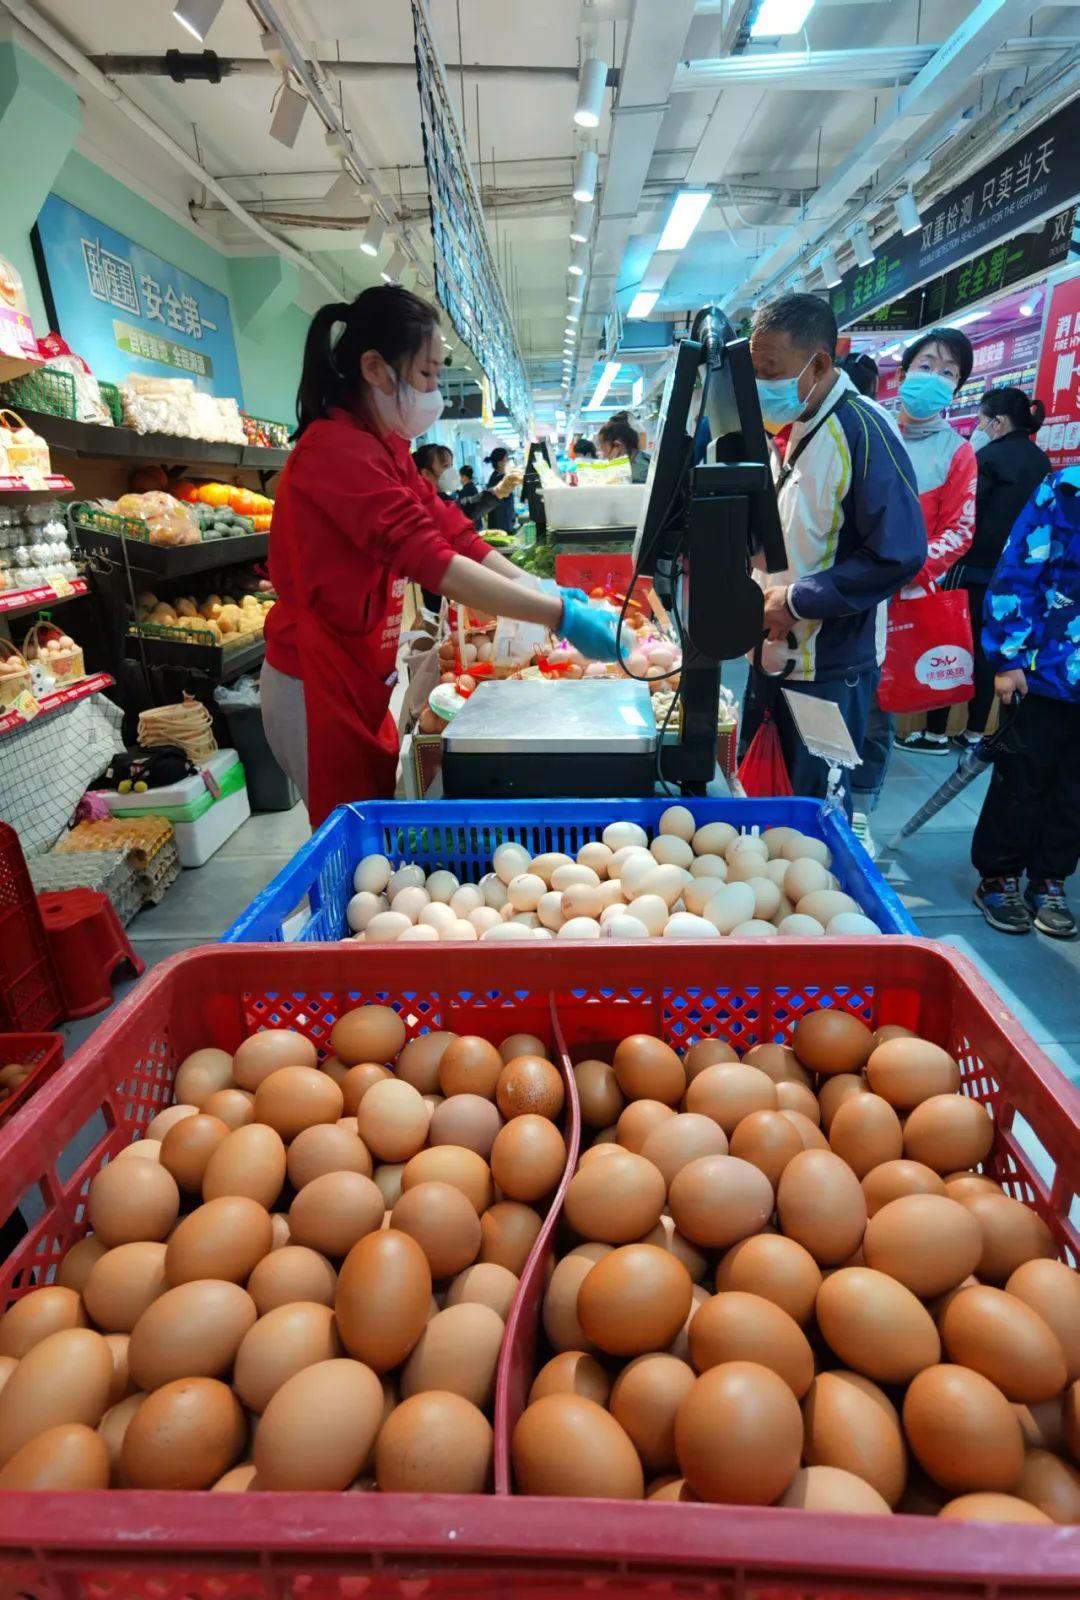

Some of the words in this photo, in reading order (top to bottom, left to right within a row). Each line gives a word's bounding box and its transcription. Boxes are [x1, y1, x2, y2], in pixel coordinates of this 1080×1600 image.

[920, 191, 974, 252] 双重检测
[979, 137, 1054, 216] 只卖当天
[1003, 204, 1016, 219] THE
[1016, 194, 1033, 211] VERY
[851, 255, 900, 310] 安全第一
[956, 247, 1024, 304] 安全第一
[140, 274, 217, 340] 安全第一
[1053, 338, 1069, 353] FIRE
